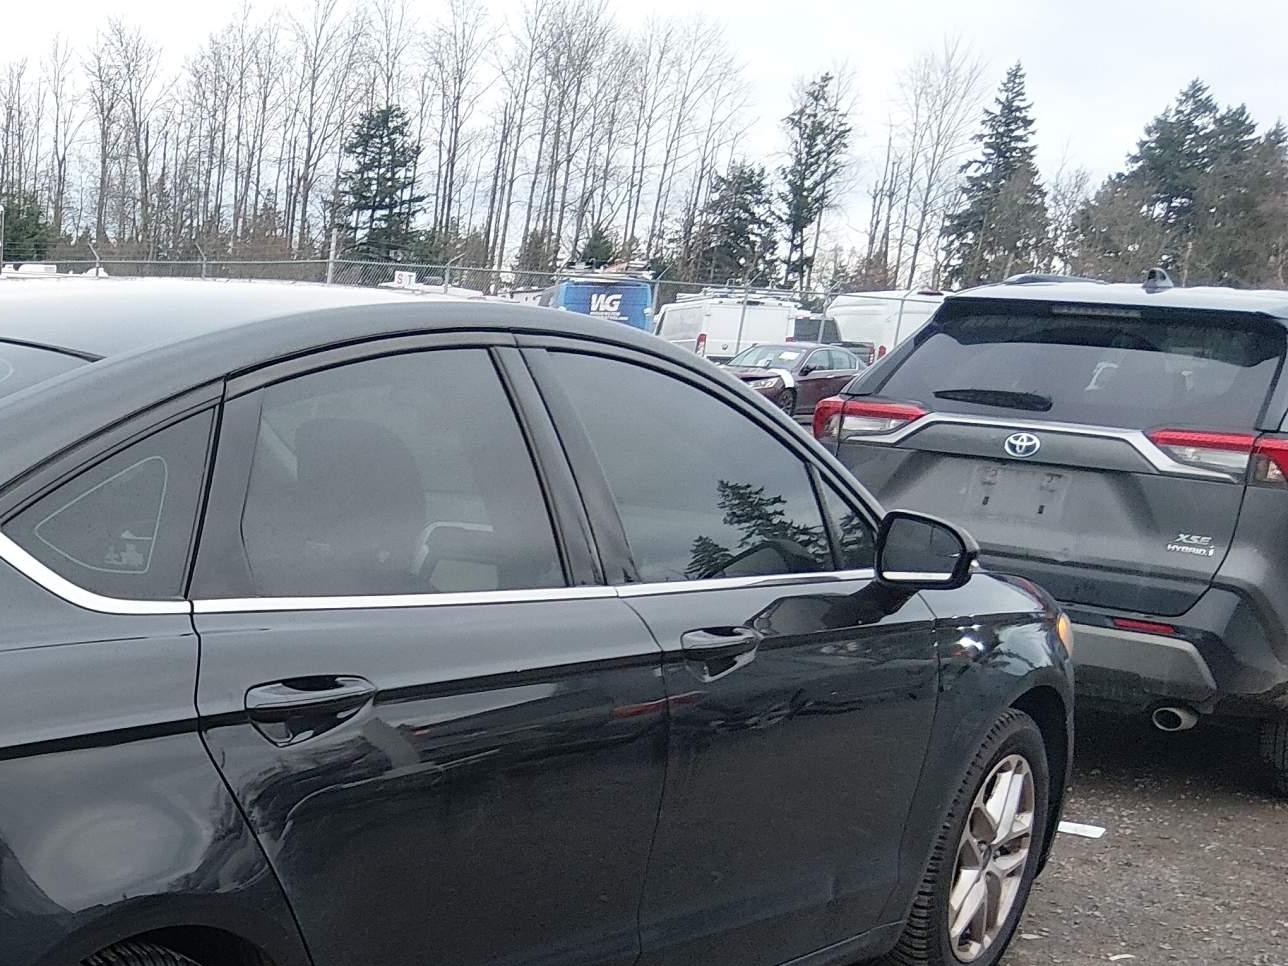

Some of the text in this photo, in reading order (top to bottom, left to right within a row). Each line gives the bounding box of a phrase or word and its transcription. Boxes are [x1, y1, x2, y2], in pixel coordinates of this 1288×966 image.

[397, 273, 414, 285] S T
[1175, 533, 1213, 545] XSE
